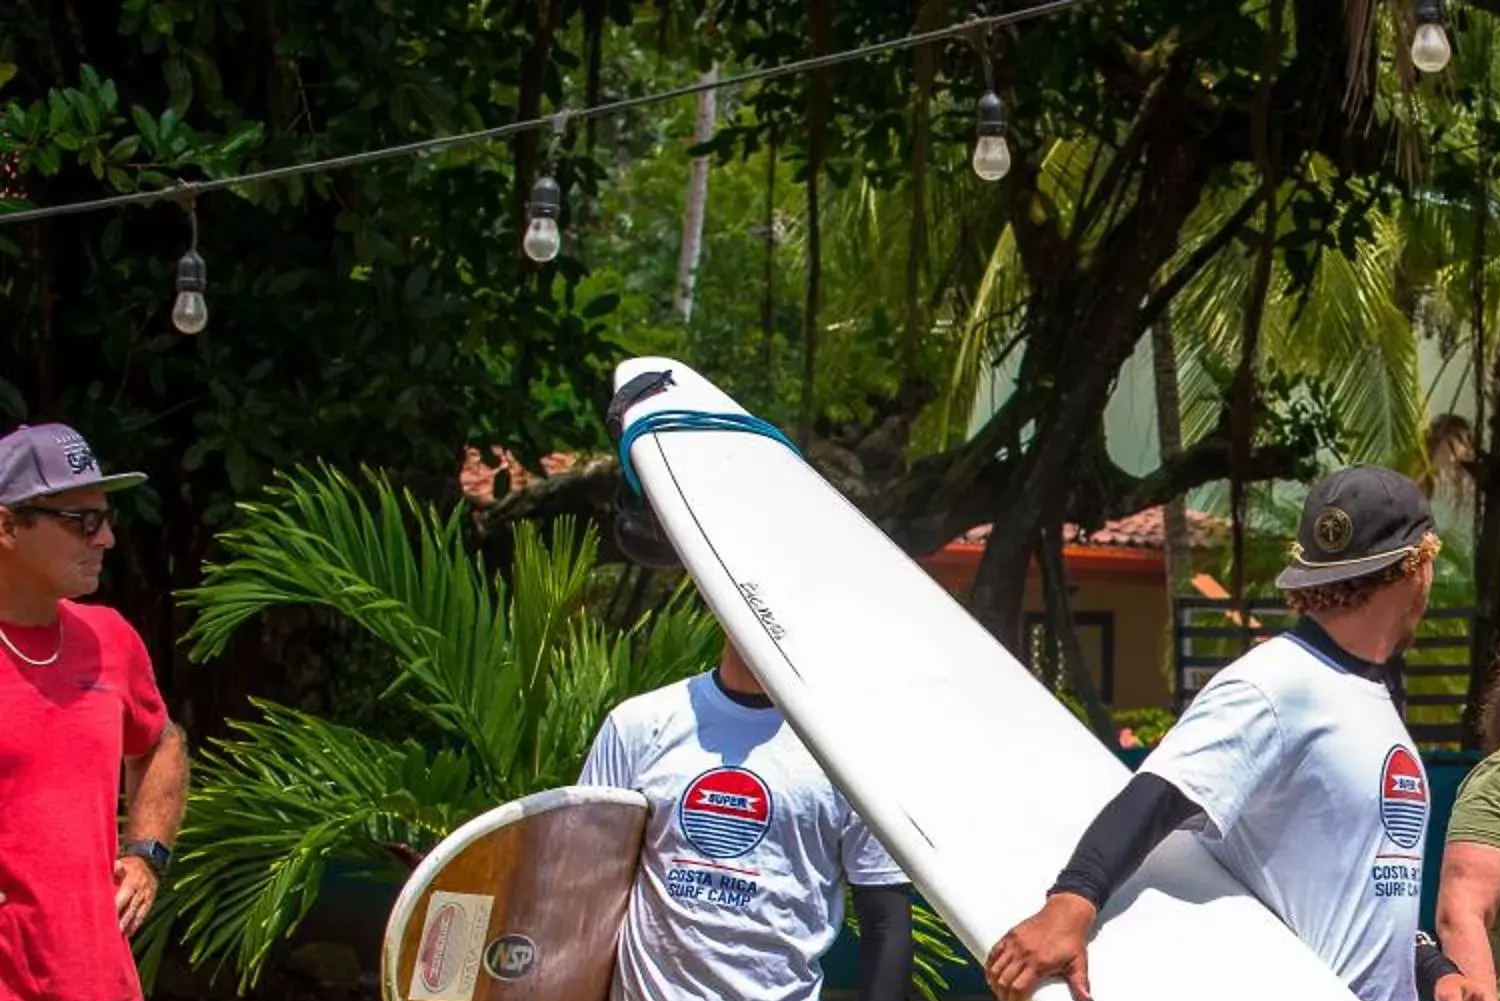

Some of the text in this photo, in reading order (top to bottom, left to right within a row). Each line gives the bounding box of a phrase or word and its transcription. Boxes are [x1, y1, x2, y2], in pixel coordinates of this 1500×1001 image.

[708, 794, 748, 808] SUPER
[668, 869, 758, 894] COSTA RICA
[1373, 865, 1408, 882] COSTA
[668, 884, 751, 907] SURF CAMP
[1375, 881, 1405, 897] SURF
[491, 942, 534, 971] NSP
